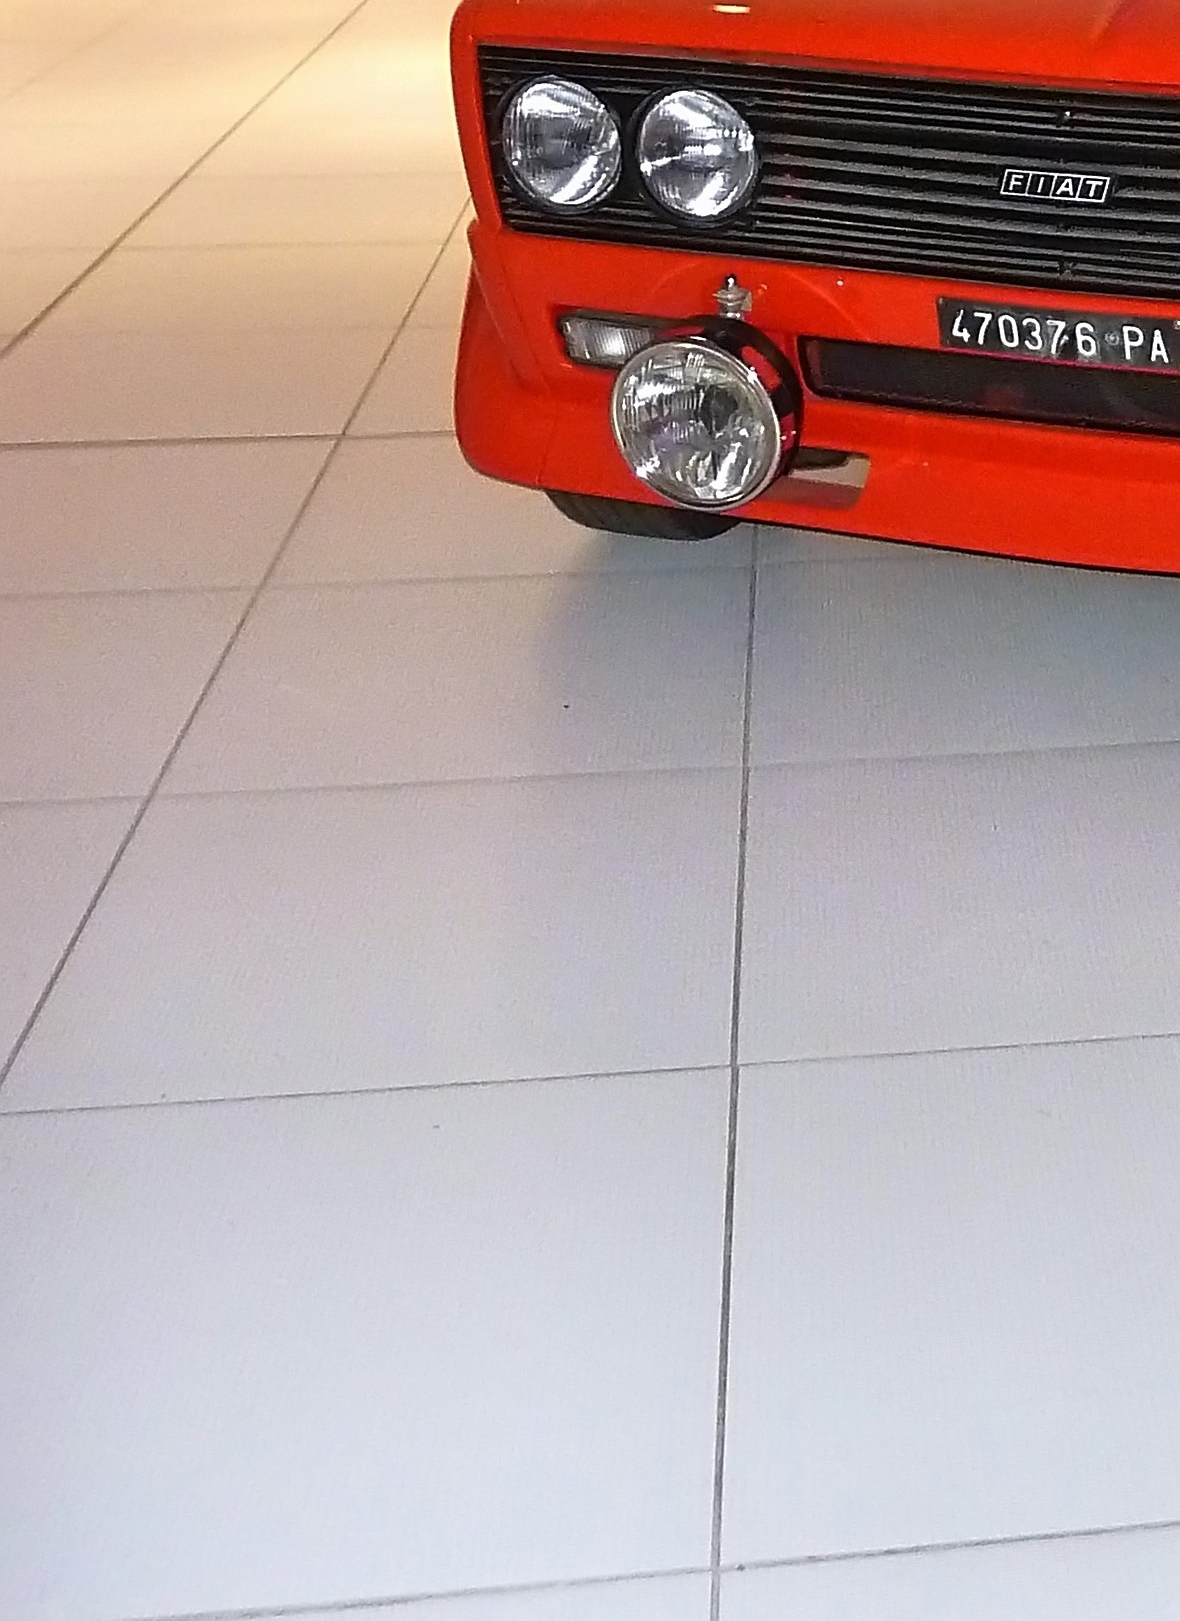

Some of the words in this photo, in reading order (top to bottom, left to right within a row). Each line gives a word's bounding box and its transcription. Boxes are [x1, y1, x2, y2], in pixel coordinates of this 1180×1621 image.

[1006, 173, 1105, 199] FIAT
[951, 308, 1098, 357] 470376
[1121, 325, 1170, 364] PA
